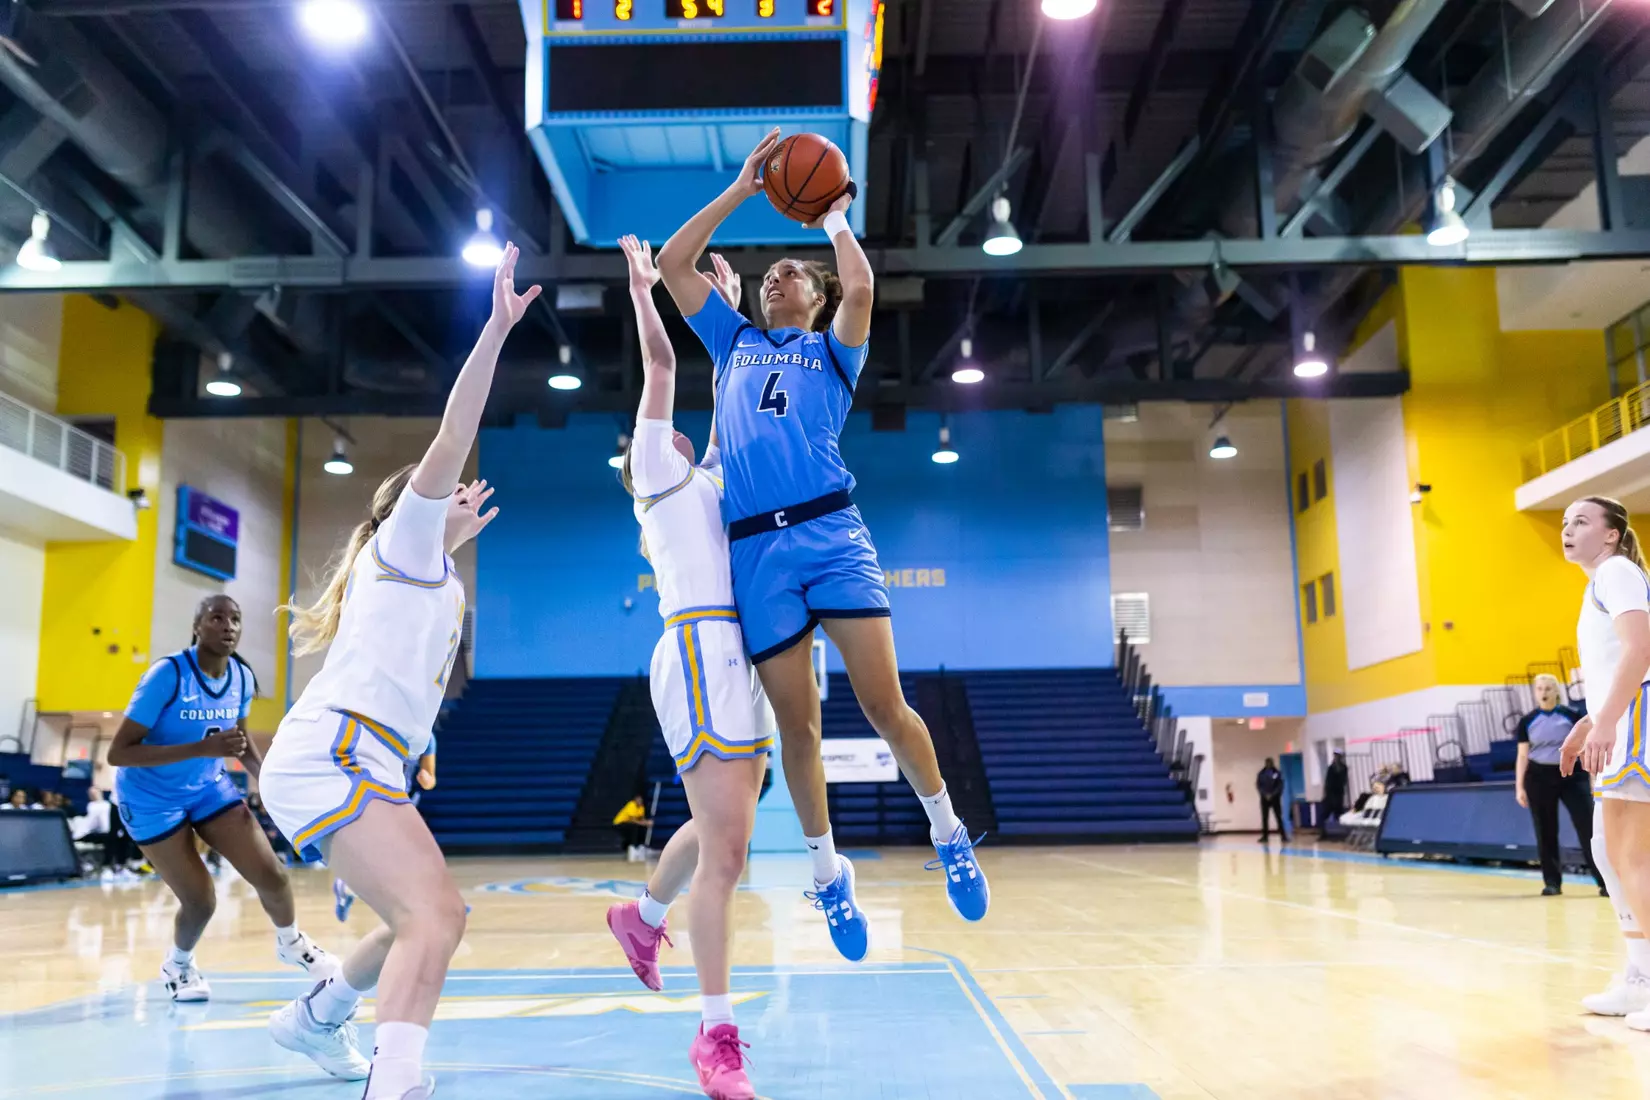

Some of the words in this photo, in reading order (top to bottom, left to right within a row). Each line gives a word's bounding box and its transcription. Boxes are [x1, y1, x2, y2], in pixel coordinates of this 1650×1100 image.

[734, 353, 823, 371] COLUMBIA
[756, 370, 789, 418] 4
[774, 510, 788, 528] C
[885, 568, 945, 587] HERS
